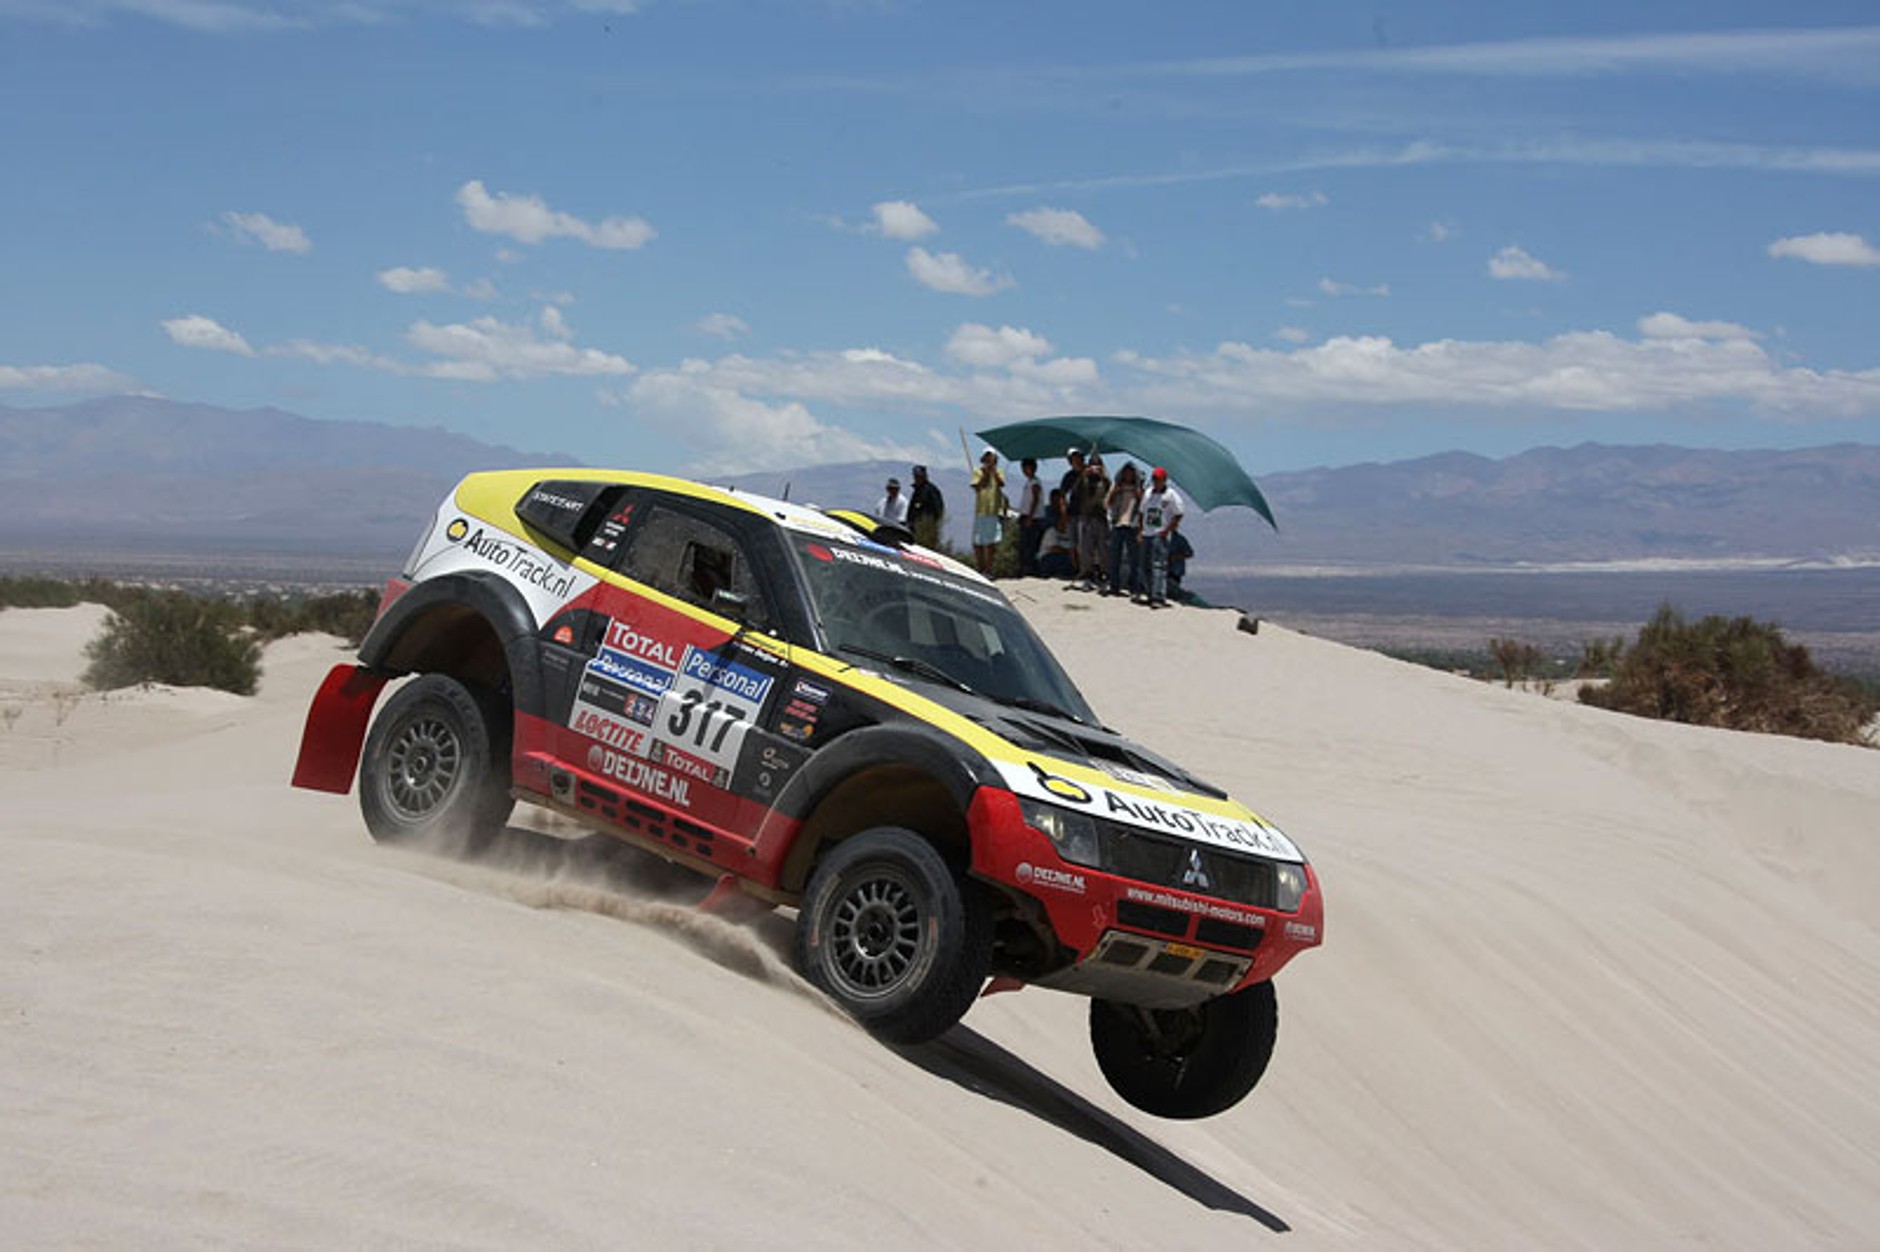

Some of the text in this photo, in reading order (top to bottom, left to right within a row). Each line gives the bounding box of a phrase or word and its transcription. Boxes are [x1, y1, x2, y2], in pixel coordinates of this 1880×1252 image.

[467, 528, 576, 599] AutoTrack.nl
[613, 621, 677, 667] TOTAL
[687, 651, 767, 699] Personal
[573, 708, 646, 752] LOCTITE
[668, 690, 746, 753] 317
[602, 750, 691, 807] DEIJNE.NL
[665, 750, 710, 783] TOTAL
[1127, 888, 1266, 926] www.mitsubishi-motors.com
